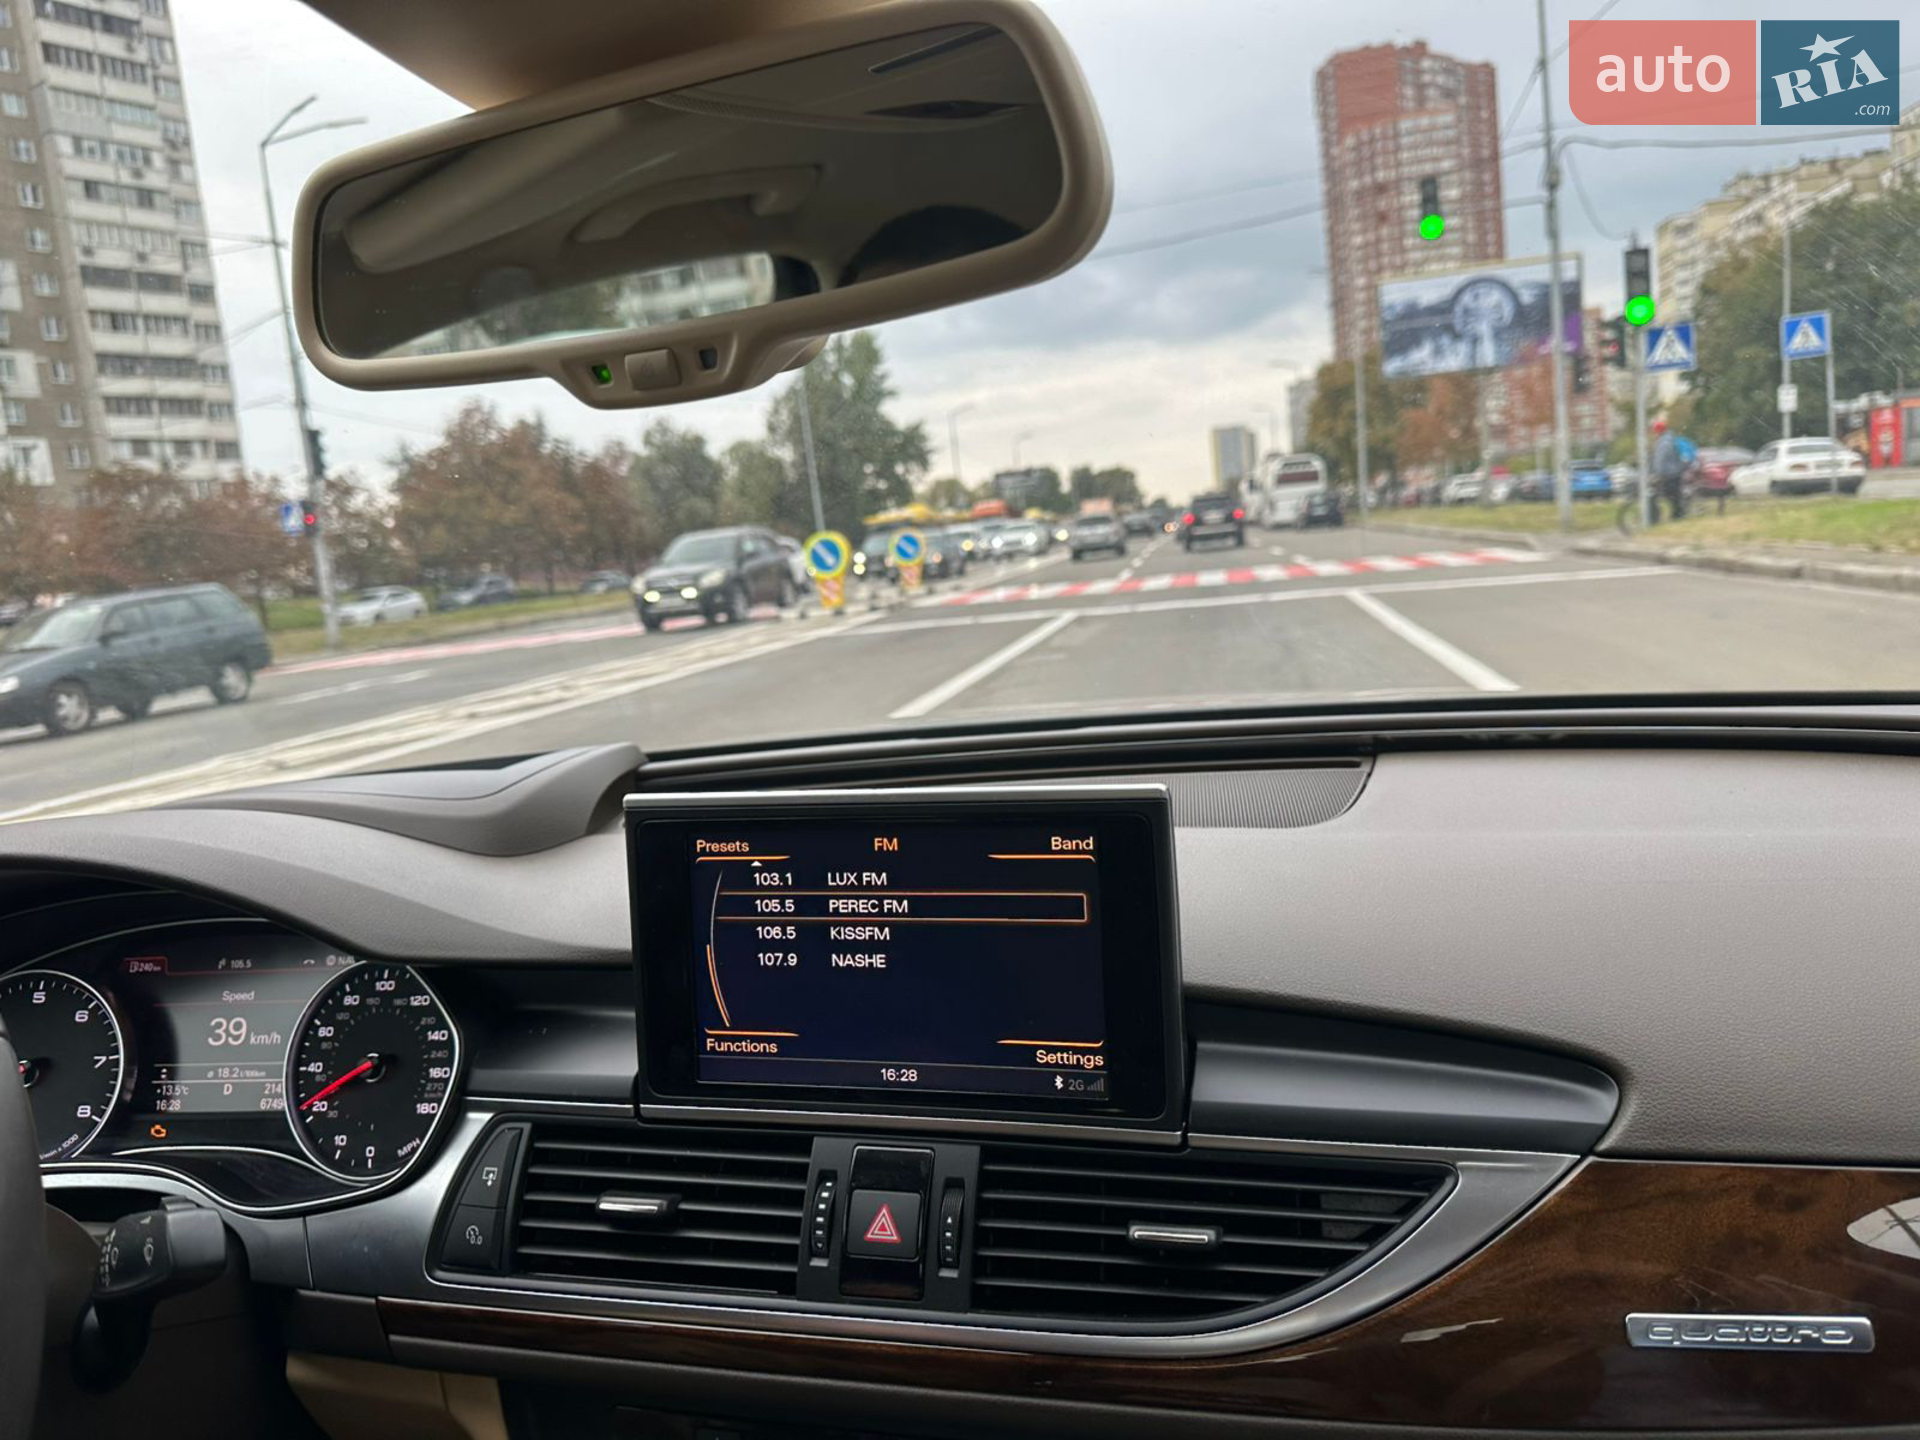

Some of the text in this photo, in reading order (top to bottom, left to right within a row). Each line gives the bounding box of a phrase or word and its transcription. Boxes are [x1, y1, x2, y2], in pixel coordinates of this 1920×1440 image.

[695, 837, 750, 855] Presets
[873, 837, 898, 852] FM
[1050, 836, 1094, 851] Band
[753, 872, 793, 887] 103.1
[827, 872, 888, 887] LUX FM
[754, 899, 796, 914] 105.5
[828, 899, 909, 915] PEREC FM
[755, 926, 797, 941] 106.5
[830, 927, 891, 942] KISSFM
[757, 953, 798, 968] 107.9
[831, 953, 887, 970] NASHE
[375, 980, 396, 991] 100
[32, 991, 46, 1004] 5
[222, 991, 255, 1003] Speed
[343, 995, 360, 1006] 80
[409, 995, 430, 1007] 120
[75, 1010, 89, 1022] 6
[208, 1017, 281, 1046] 39 km/h
[317, 1027, 334, 1037] 60
[427, 1030, 449, 1041] 140
[706, 1038, 778, 1055] Functions
[93, 1056, 107, 1069] 7
[1035, 1050, 1105, 1068] Settings
[218, 1067, 240, 1079] 18.2
[307, 1062, 323, 1073] 40
[428, 1067, 450, 1079] 160
[880, 1067, 918, 1083] 16:28
[223, 1084, 233, 1095] D
[1067, 1078, 1085, 1092] 2G
[77, 1105, 91, 1118] 8
[156, 1099, 181, 1111] 16:28
[312, 1101, 328, 1112] 20
[416, 1103, 438, 1114] 180
[334, 1135, 347, 1146] 10
[397, 1137, 421, 1157] MPH
[366, 1147, 375, 1157] 0
